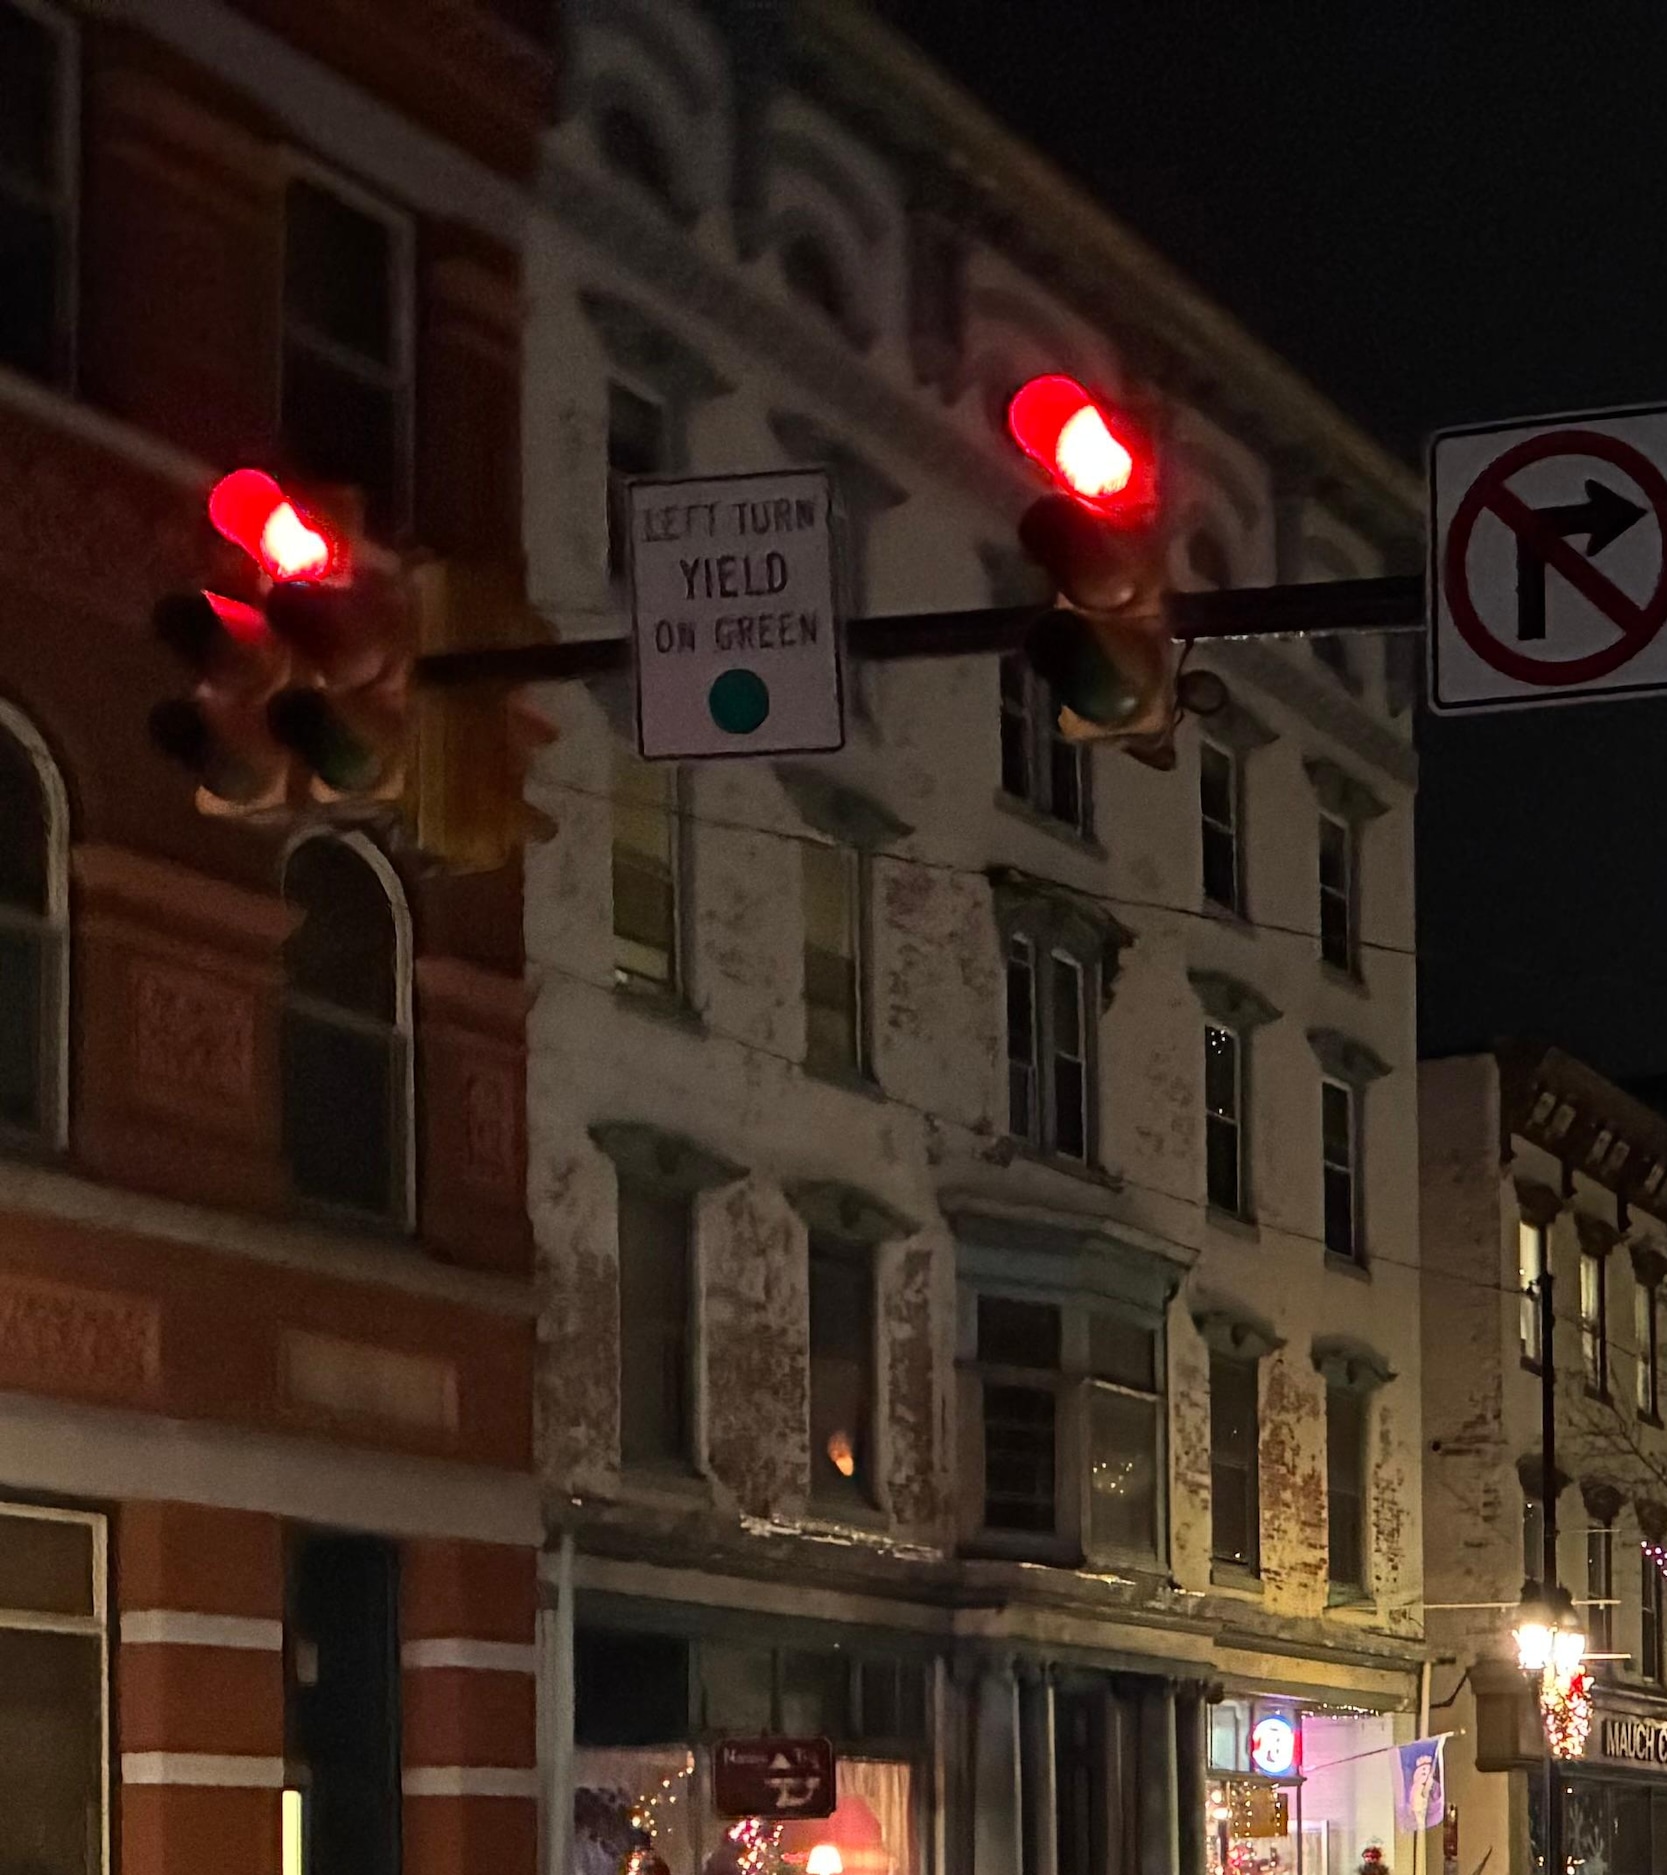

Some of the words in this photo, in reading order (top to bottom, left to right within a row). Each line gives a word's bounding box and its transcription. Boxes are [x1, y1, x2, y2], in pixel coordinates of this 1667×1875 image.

[643, 503, 717, 542] LEFT
[729, 498, 815, 536] TURN
[679, 551, 788, 600] YIELD
[655, 619, 696, 653] ON
[714, 611, 818, 651] GREEN
[1604, 1720, 1655, 1761] MAUCH
